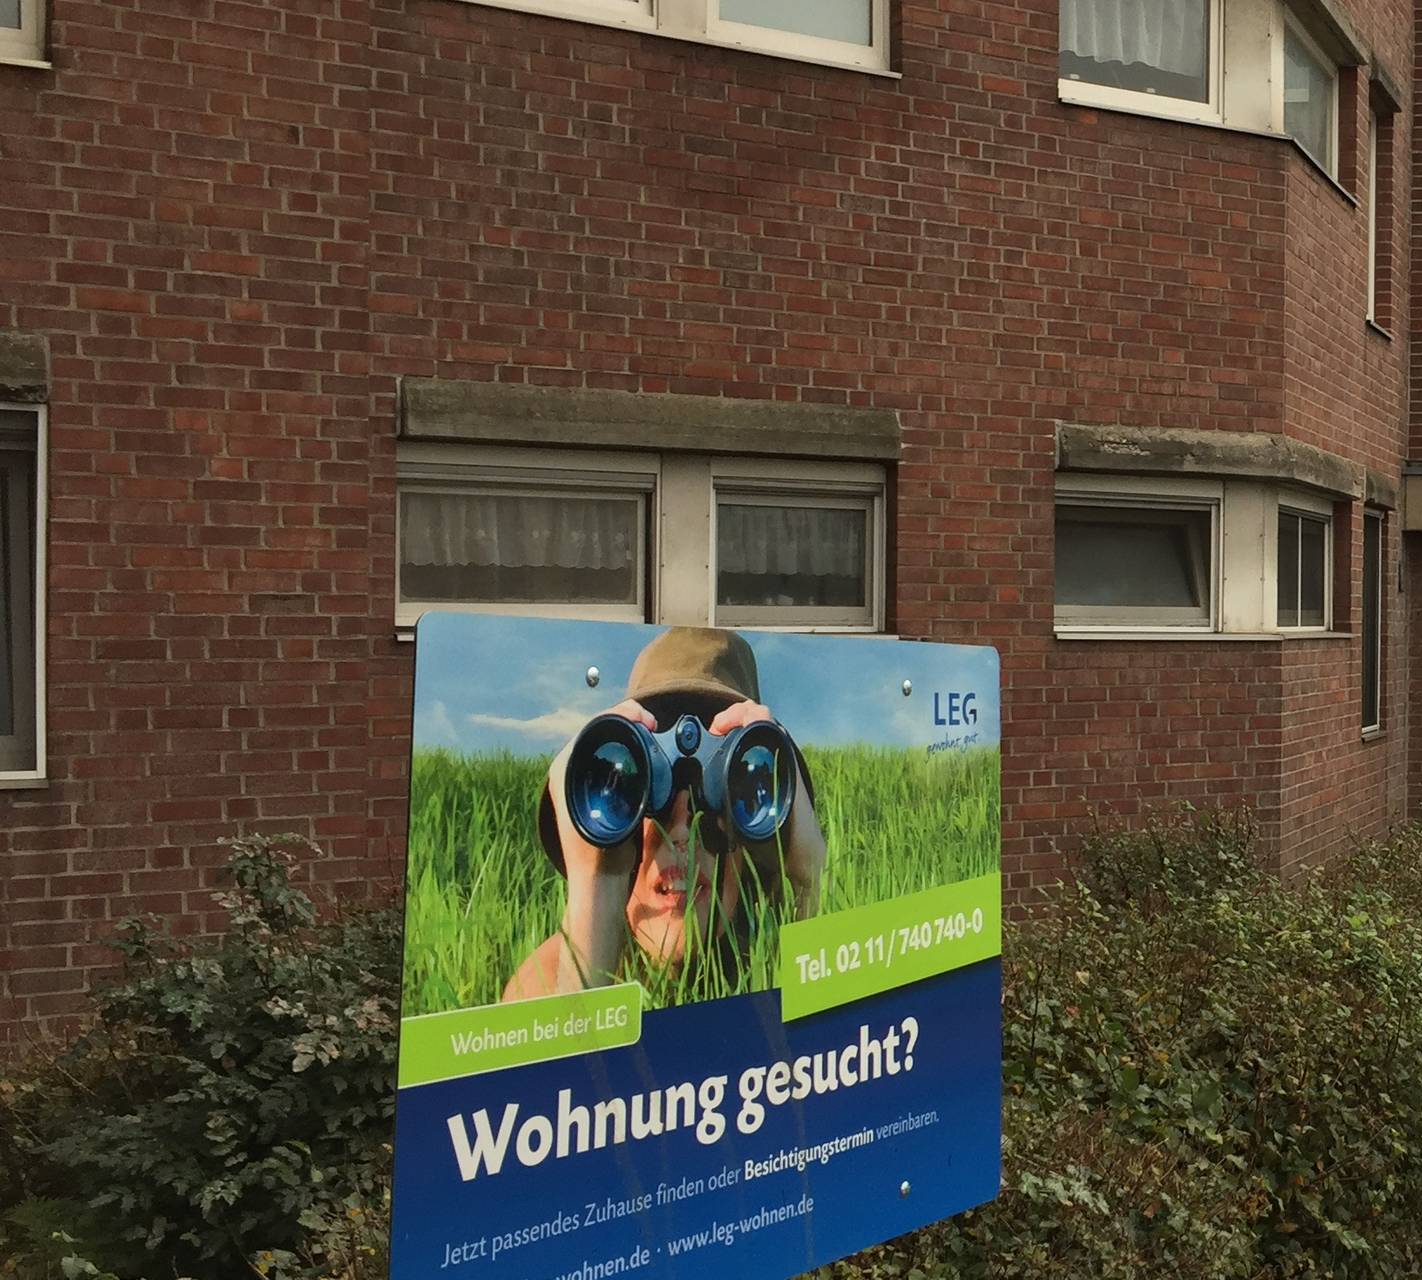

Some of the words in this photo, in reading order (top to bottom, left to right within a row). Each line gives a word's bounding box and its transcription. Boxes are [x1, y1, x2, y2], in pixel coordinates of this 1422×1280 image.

[934, 692, 977, 725] LEG
[795, 948, 832, 984] Tel.
[835, 941, 861, 973] 02
[865, 934, 884, 964] 11
[899, 921, 932, 955] 740
[935, 907, 983, 945] 740-0
[451, 1026, 528, 1056] Wohnen
[533, 1019, 559, 1042] bei
[564, 1013, 592, 1036] der
[595, 1005, 628, 1031] LEG
[447, 1074, 728, 1182] Wohnung
[736, 1016, 919, 1134] gesucht?
[440, 1237, 487, 1269] Jetzt
[492, 1210, 580, 1261] passendes
[583, 1191, 653, 1228] Zuhause
[656, 1176, 704, 1206] finden
[708, 1164, 742, 1191] oder
[745, 1127, 874, 1181] Besichtigungstermin
[876, 1109, 940, 1140] vereinbaren.
[668, 1195, 814, 1257] www.leg-wohnen.de
